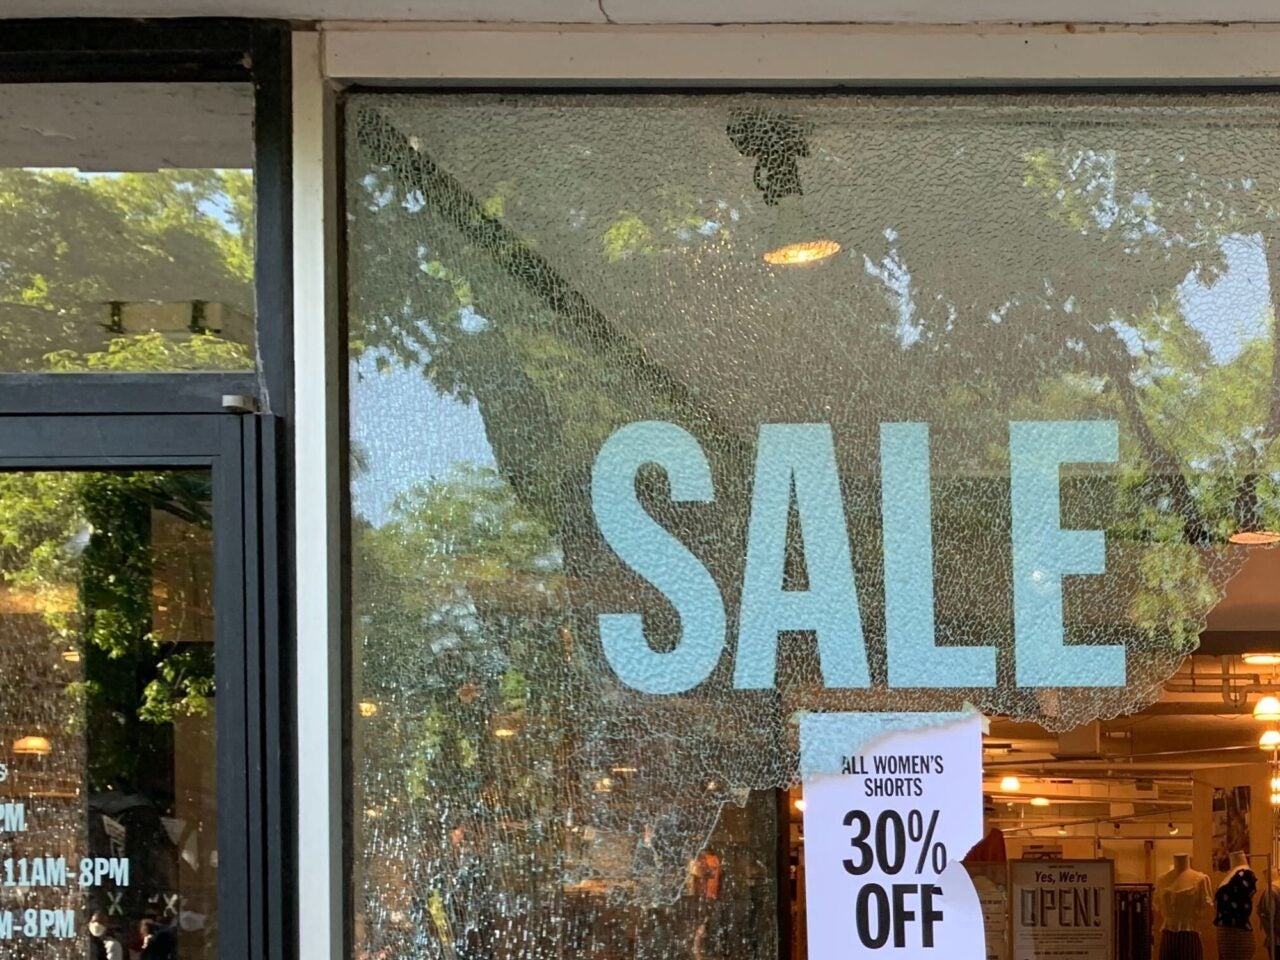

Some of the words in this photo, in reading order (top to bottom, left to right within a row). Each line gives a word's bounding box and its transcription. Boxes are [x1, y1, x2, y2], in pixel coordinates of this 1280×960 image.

[591, 420, 1126, 694] SALE
[842, 756, 868, 774] ALL
[873, 755, 944, 774] WOMEN'S
[864, 778, 923, 797] SHORTS
[842, 809, 947, 875] 30%
[1035, 872, 1056, 884] Yes,
[1059, 871, 1088, 883] We're
[856, 883, 943, 949] OFF
[1021, 887, 1104, 927] OPEN!
